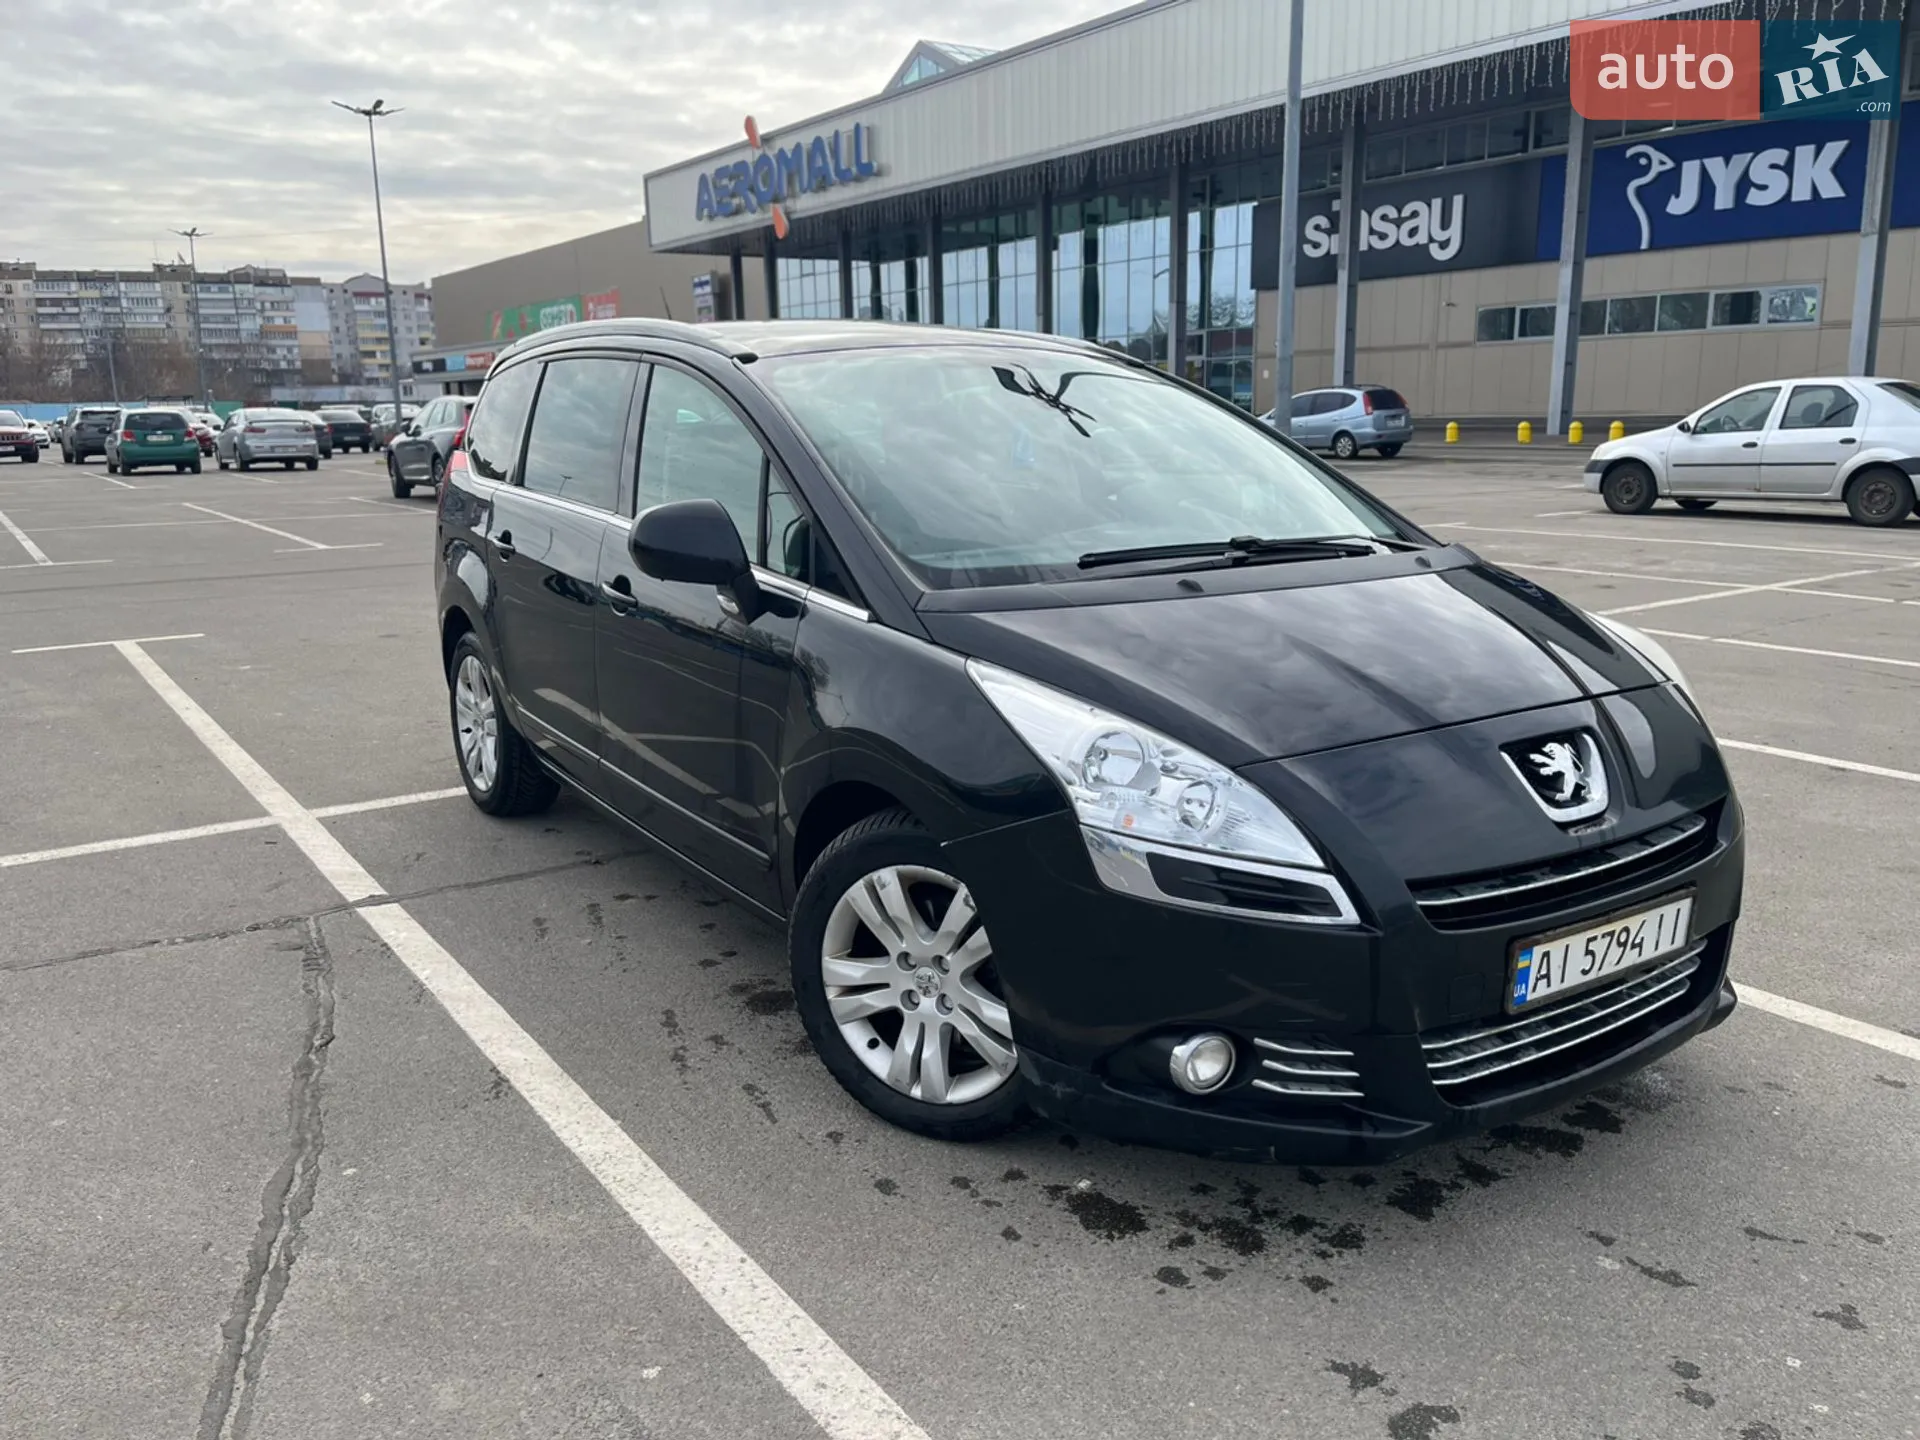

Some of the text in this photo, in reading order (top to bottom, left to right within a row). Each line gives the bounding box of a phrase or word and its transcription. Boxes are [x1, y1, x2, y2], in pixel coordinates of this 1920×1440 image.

[696, 122, 874, 221] AEROMALL
[1665, 140, 1850, 215] JYSK
[1513, 983, 1527, 997] UA
[1532, 908, 1681, 993] AI 5794 II
